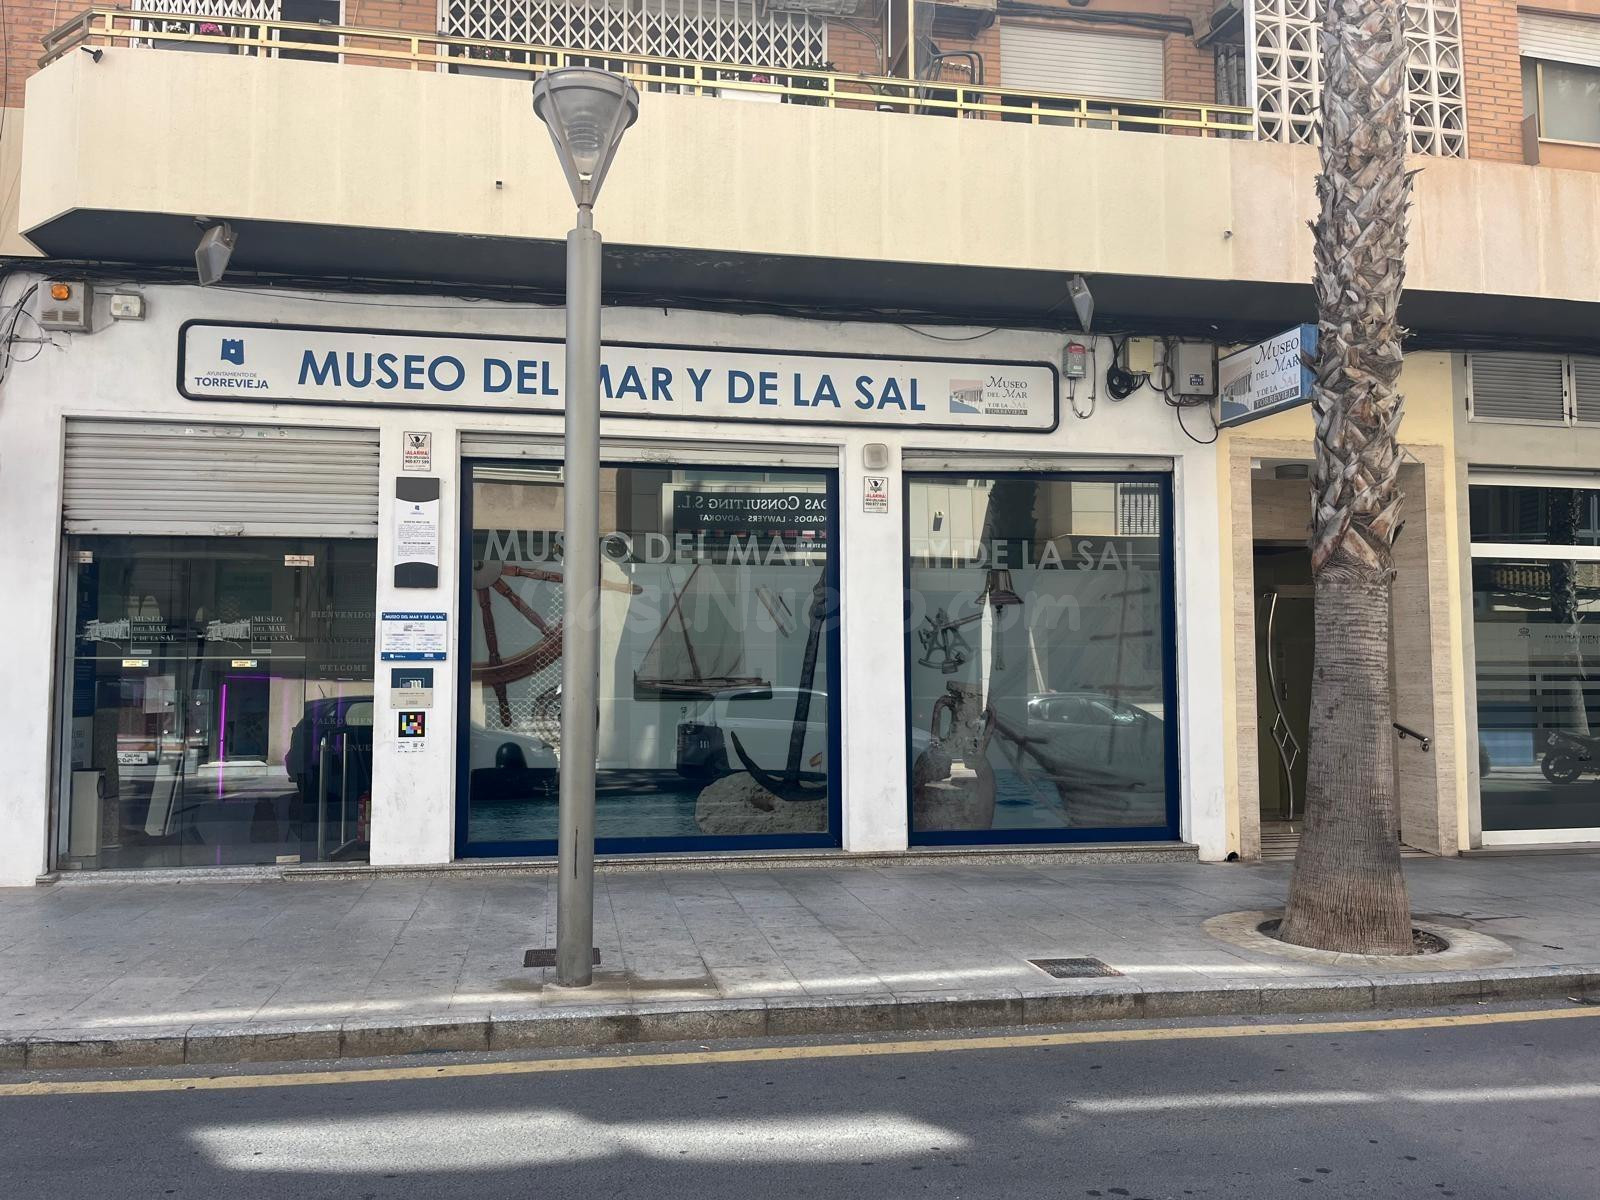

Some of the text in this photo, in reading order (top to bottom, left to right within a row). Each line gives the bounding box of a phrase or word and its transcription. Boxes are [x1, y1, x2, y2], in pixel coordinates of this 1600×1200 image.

[1256, 338, 1298, 364] MUSEO
[298, 350, 465, 391] MUSEO
[483, 358, 559, 395] DEL
[687, 368, 712, 401] Y
[728, 370, 778, 405] DE
[794, 373, 841, 408] LA
[854, 376, 926, 411] SAL
[1256, 354, 1300, 381] DEL MAR
[194, 377, 268, 389] TORREVIEJA
[986, 376, 1028, 388] MUSEO
[1002, 389, 1027, 398] MAR
[484, 530, 816, 566] MUSO DEL MAR
[930, 538, 1141, 571] Y DE LA SAL
